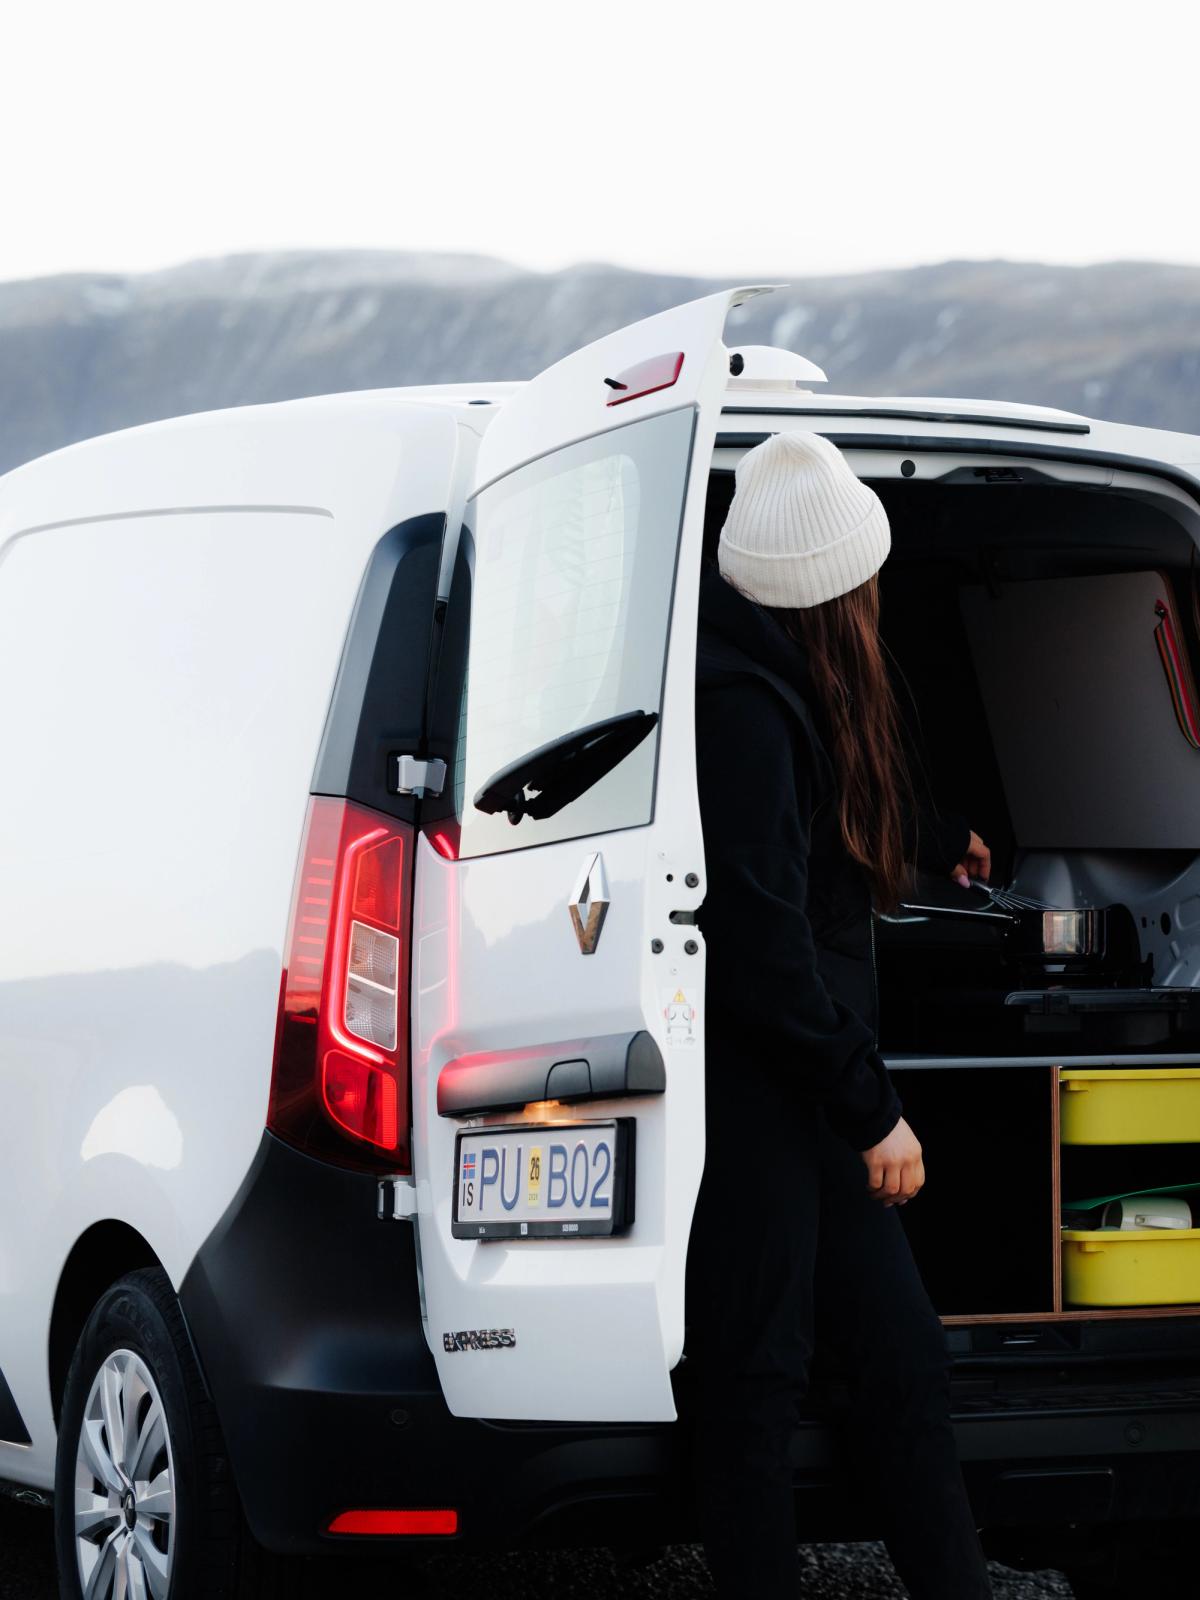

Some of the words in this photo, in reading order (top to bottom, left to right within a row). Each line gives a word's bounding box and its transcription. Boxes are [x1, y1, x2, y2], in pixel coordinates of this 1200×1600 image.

[479, 1147, 521, 1211] PU
[547, 1141, 611, 1208] B02
[530, 1157, 540, 1181] 26
[462, 1183, 474, 1206] IS
[443, 1328, 516, 1352] EXPRESS
